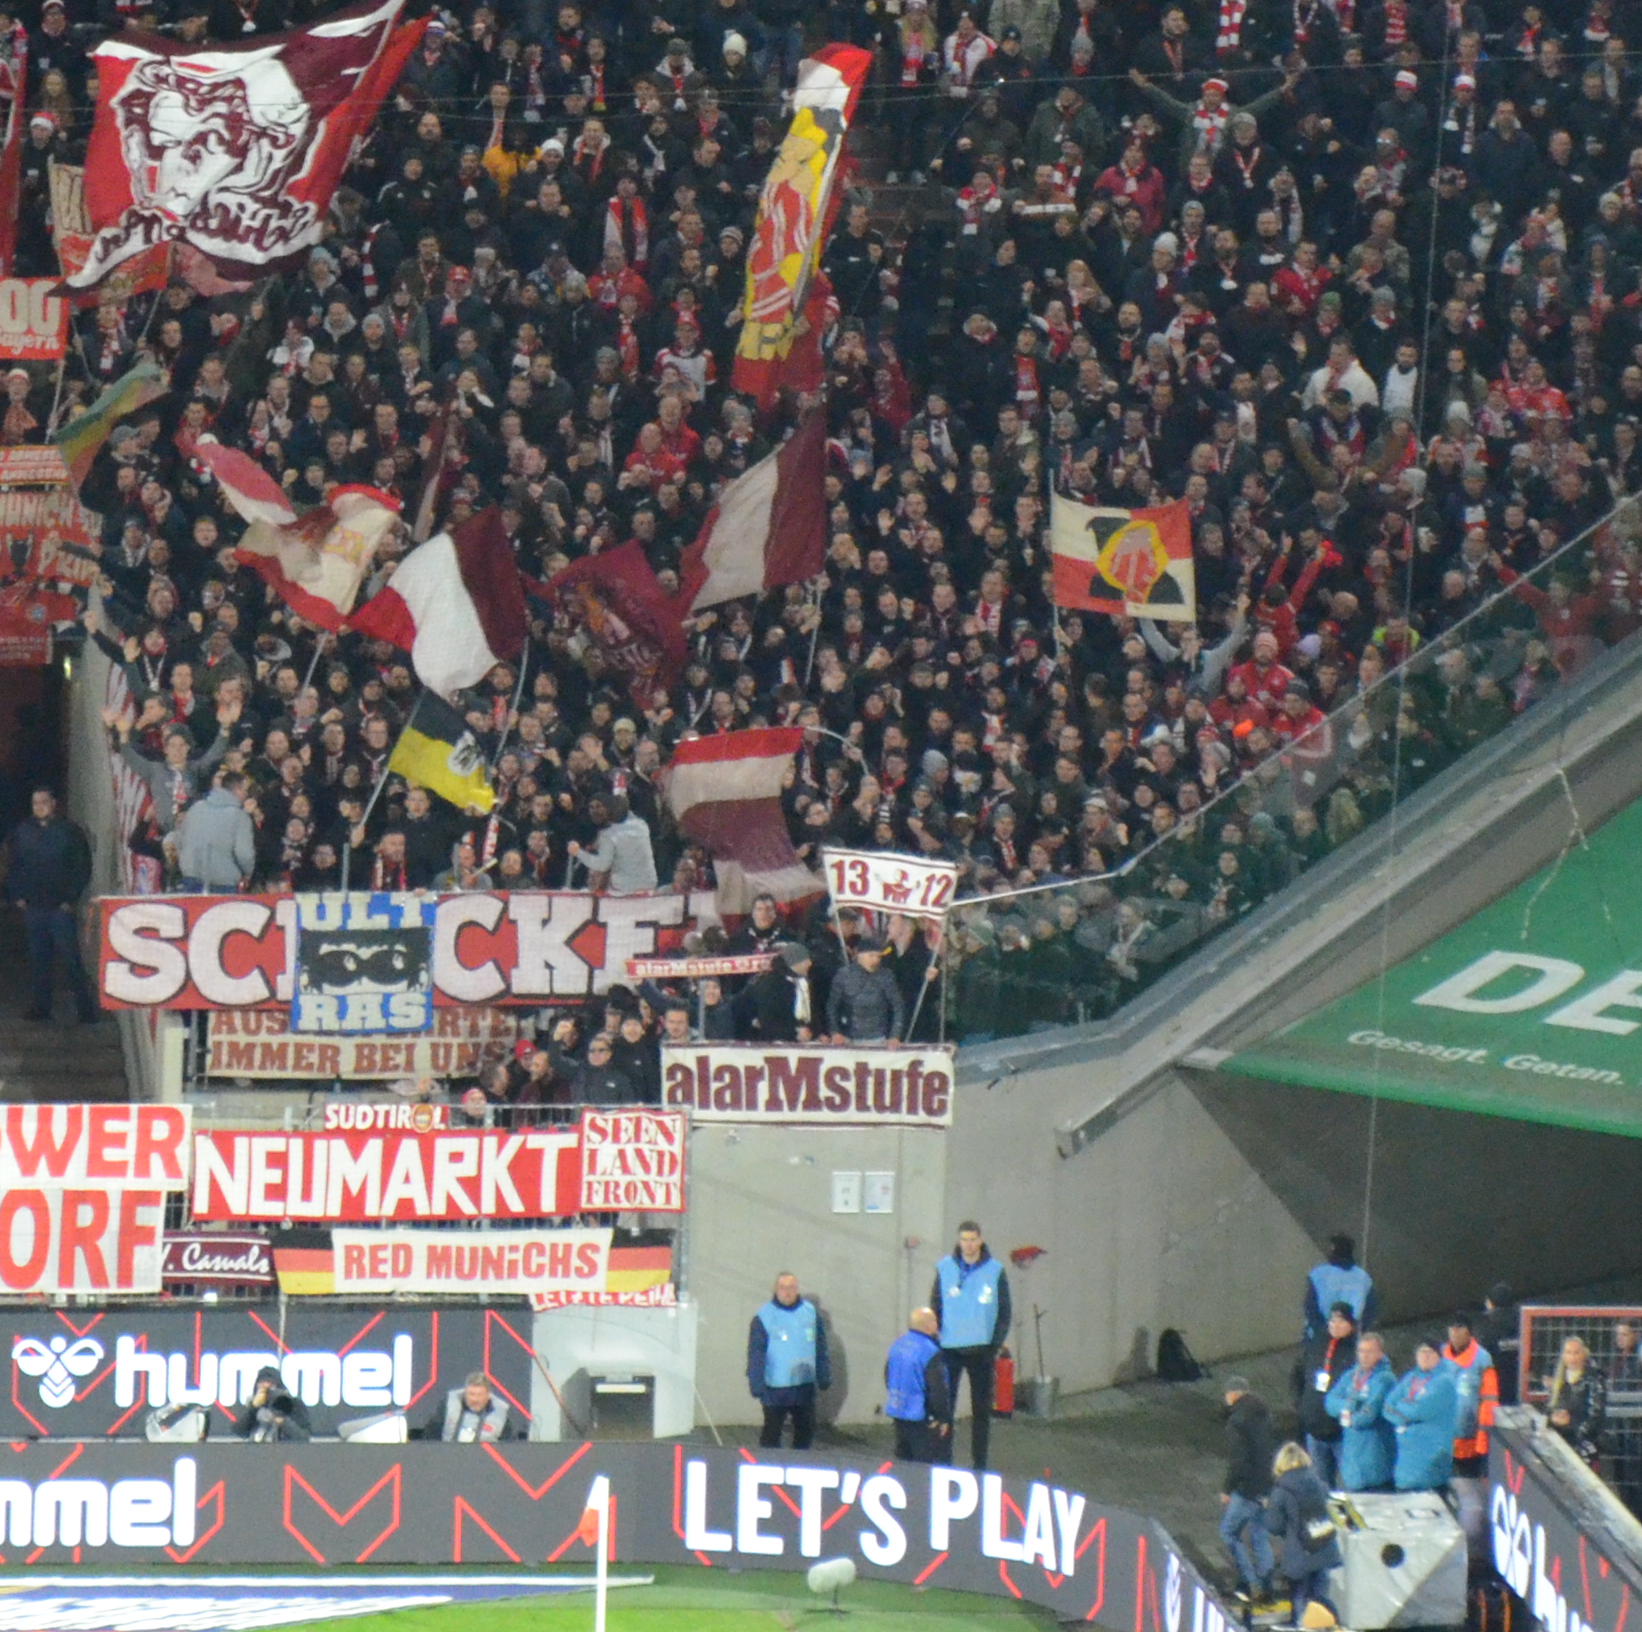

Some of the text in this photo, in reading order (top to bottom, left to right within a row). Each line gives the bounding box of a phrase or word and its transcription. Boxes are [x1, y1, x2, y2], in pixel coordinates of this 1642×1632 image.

[831, 859, 869, 896] 13
[298, 993, 427, 1030] RAS
[210, 1040, 341, 1073] IMMER
[353, 1041, 416, 1073] BEI
[1347, 1030, 1487, 1065] Gesagt.
[1502, 1053, 1625, 1086] Getan.
[666, 1056, 952, 1118] alarMstufe
[586, 1113, 680, 1144] SEEN
[194, 1132, 578, 1217] NEUMARKT
[585, 1146, 681, 1178] LAND
[585, 1179, 681, 1209] FRONT
[344, 1244, 414, 1280] RED
[115, 1334, 413, 1408] hummel
[685, 1460, 1085, 1576] LET'S PLAY
